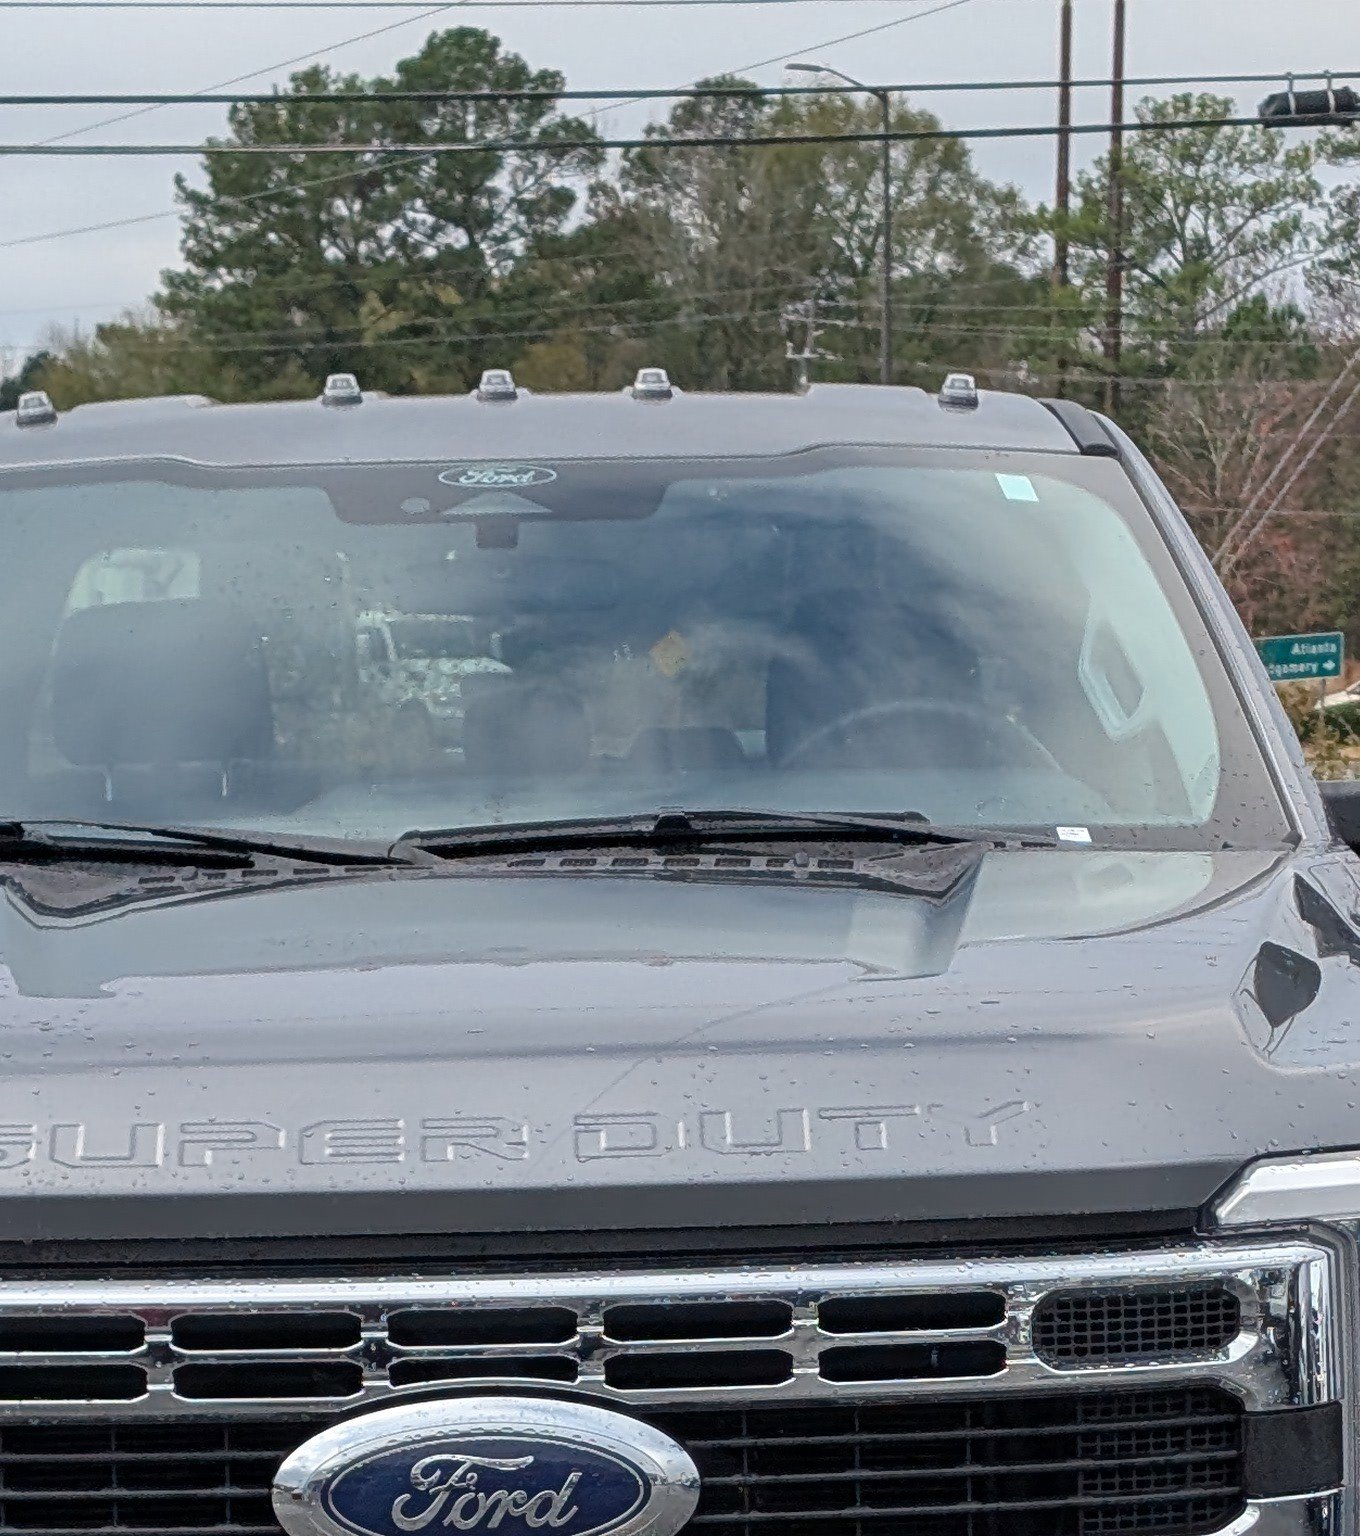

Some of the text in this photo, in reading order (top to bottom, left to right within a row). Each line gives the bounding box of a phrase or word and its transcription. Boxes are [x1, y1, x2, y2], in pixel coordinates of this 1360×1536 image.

[459, 467, 536, 484] Ford
[1291, 643, 1338, 655] Atlanta
[574, 1101, 1030, 1163] DUTY
[390, 1452, 582, 1531] Ford
